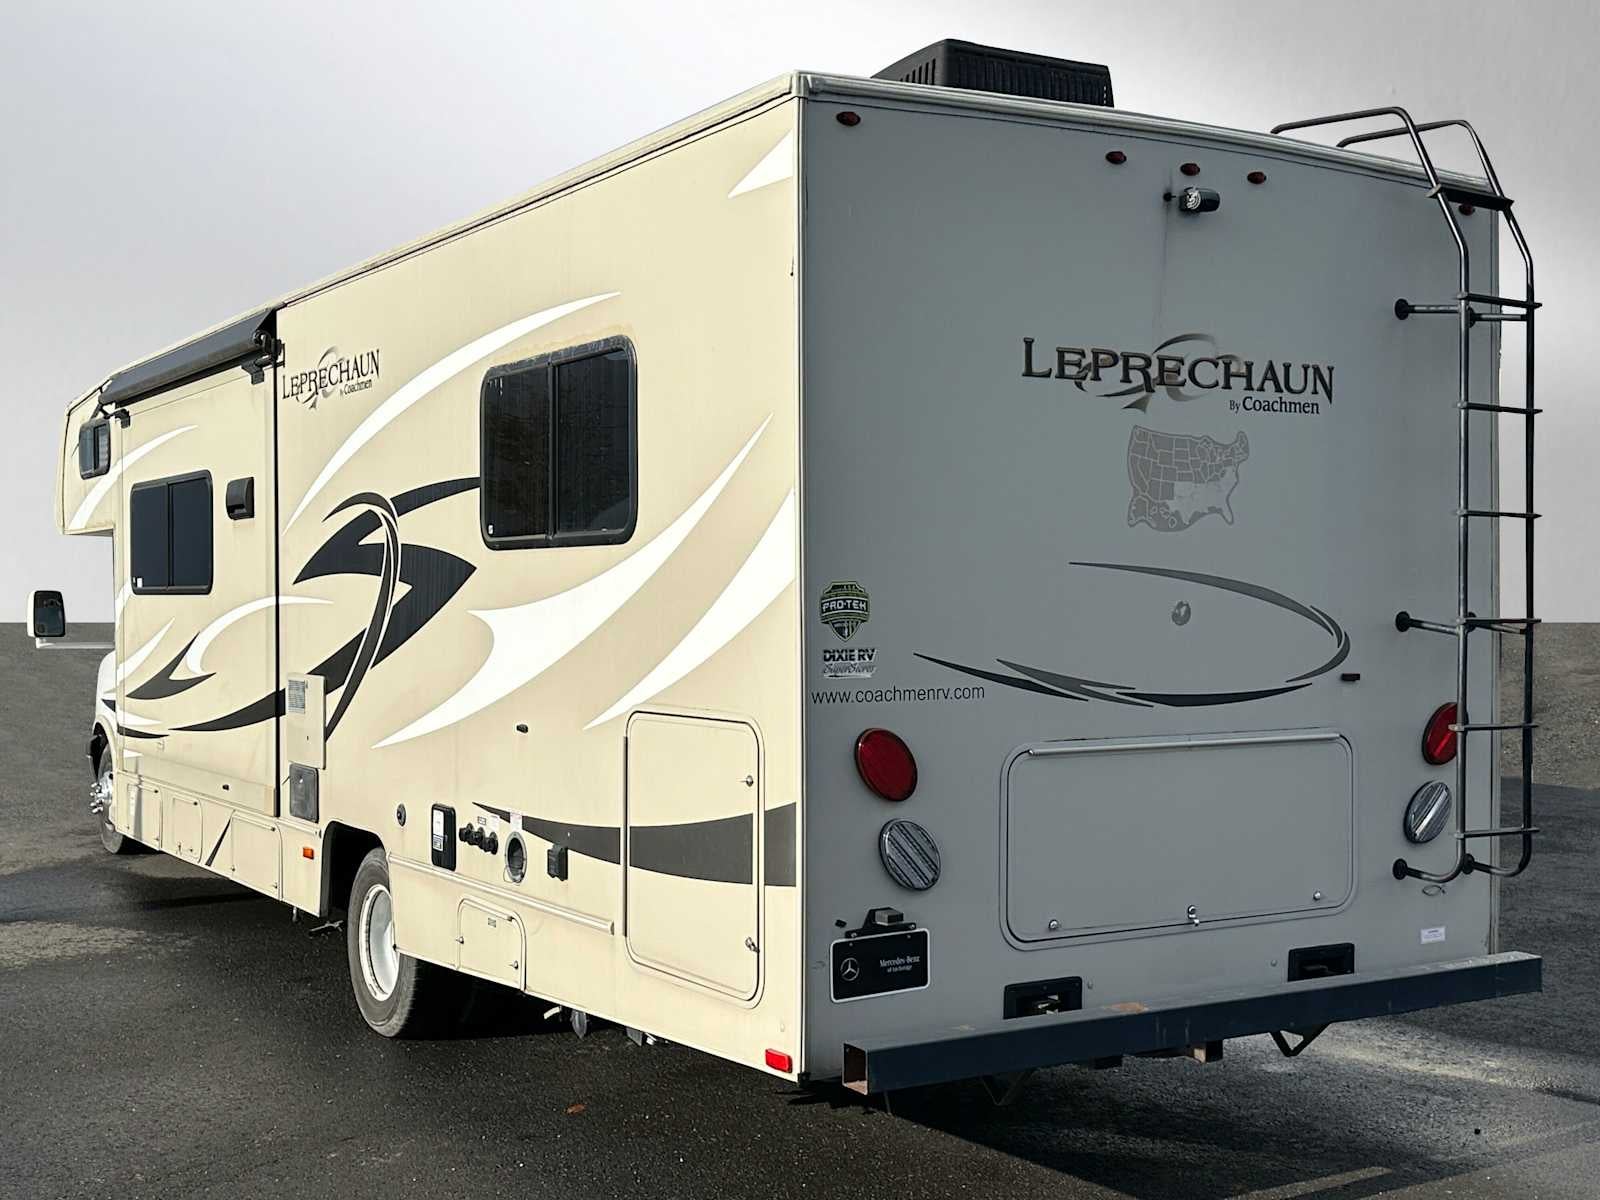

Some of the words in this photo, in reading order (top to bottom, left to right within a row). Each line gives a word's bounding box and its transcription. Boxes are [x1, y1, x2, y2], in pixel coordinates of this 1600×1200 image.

[1229, 399, 1241, 413] By
[1242, 396, 1320, 414] Coachmen
[823, 648, 856, 662] DIXIE
[857, 648, 876, 662] RV
[811, 685, 985, 704] www.coachmenrv.com
